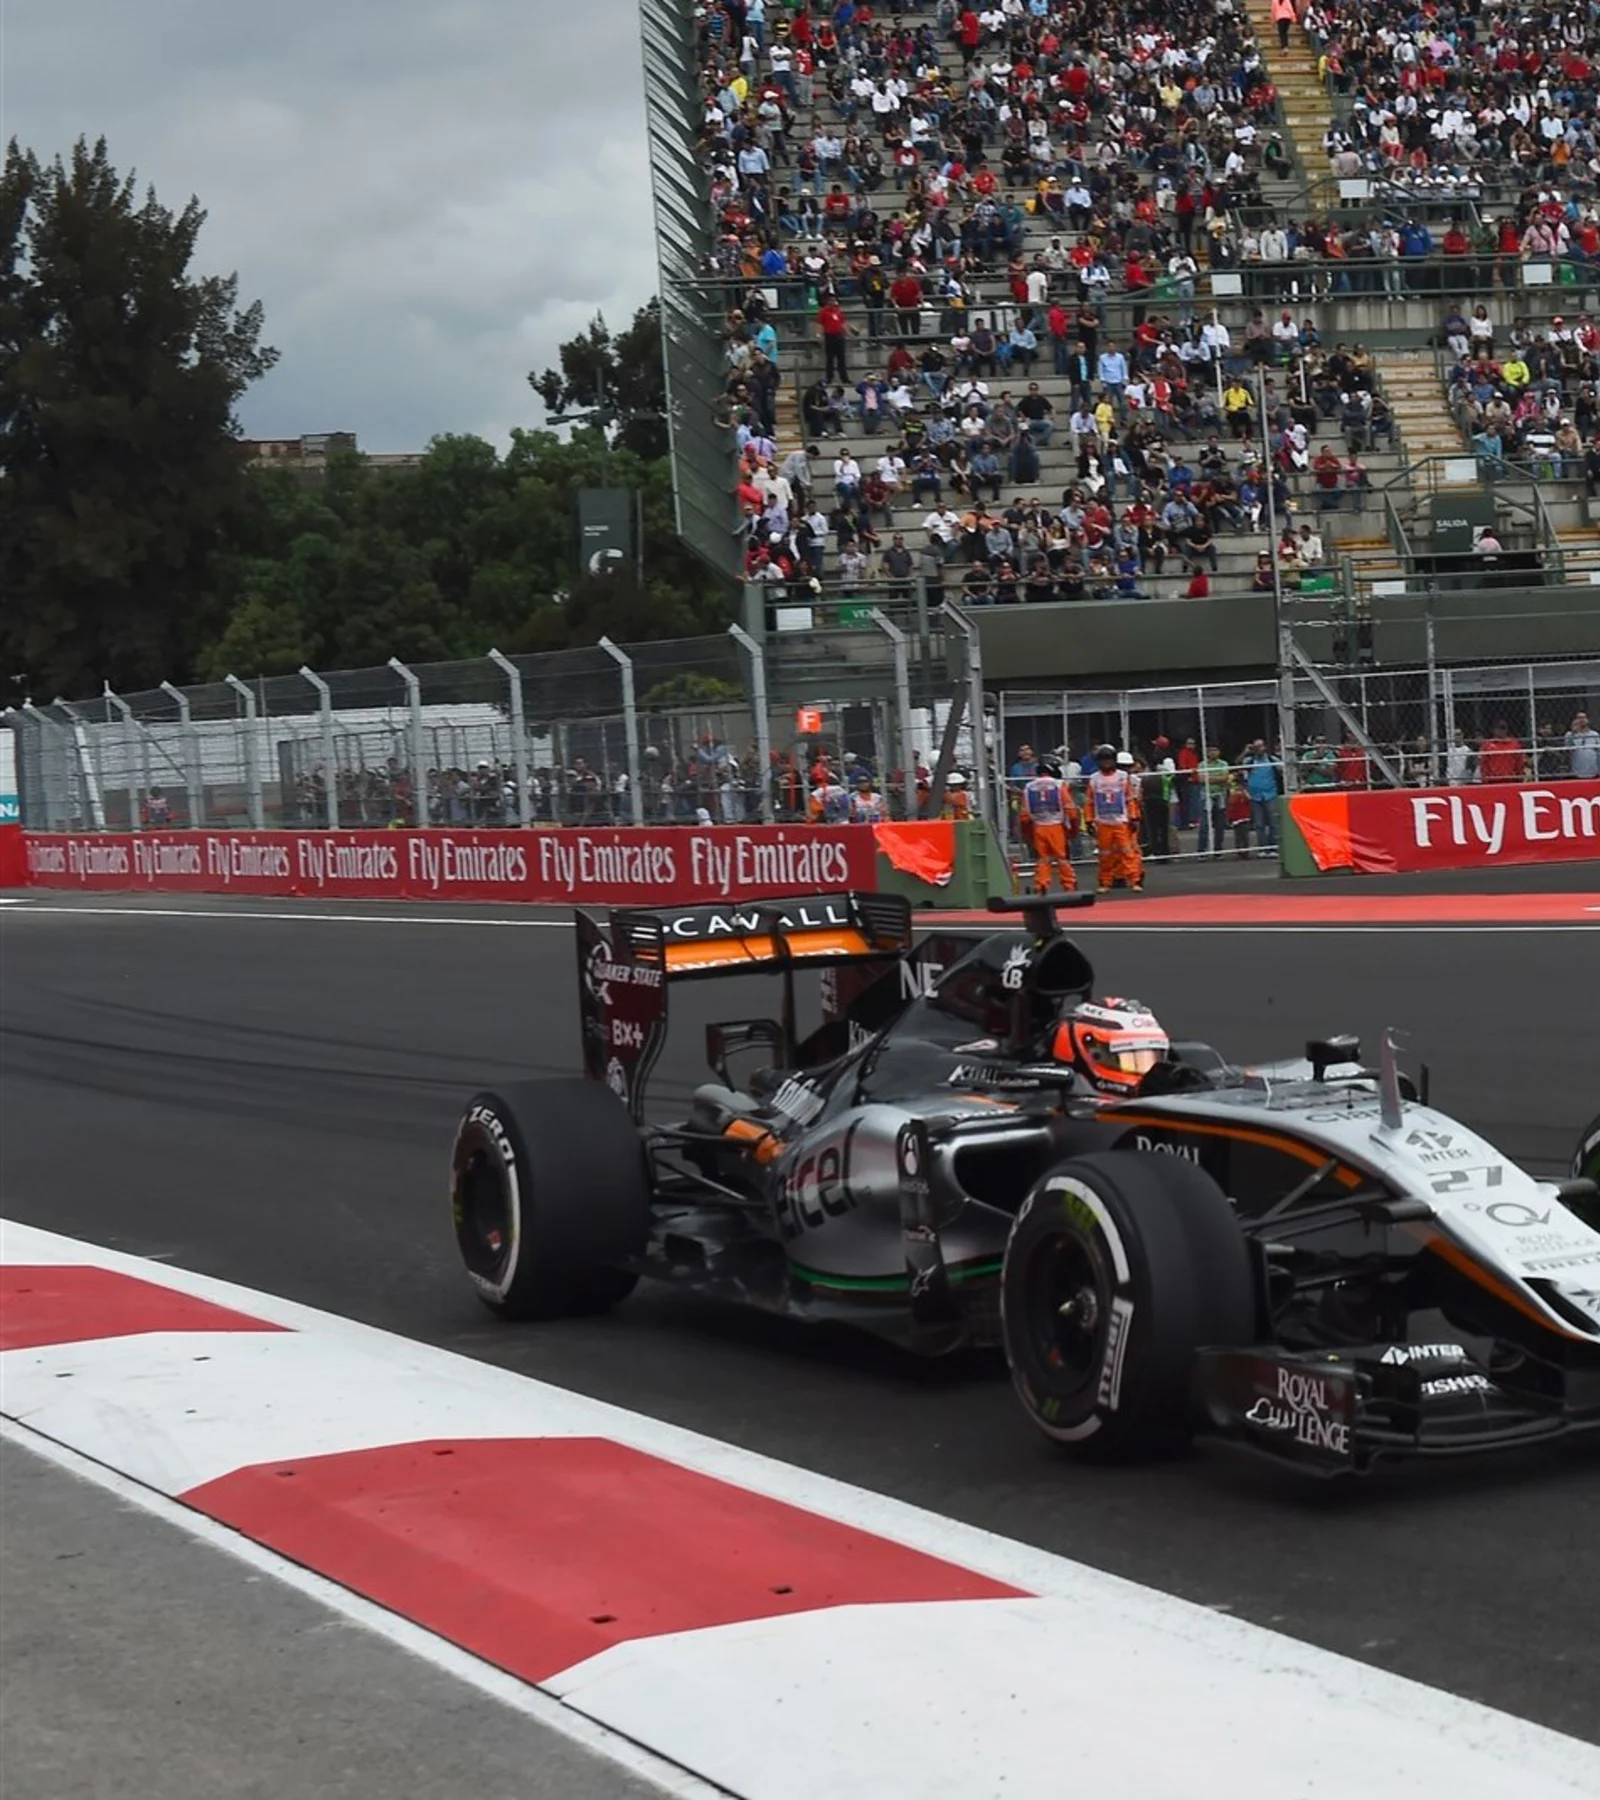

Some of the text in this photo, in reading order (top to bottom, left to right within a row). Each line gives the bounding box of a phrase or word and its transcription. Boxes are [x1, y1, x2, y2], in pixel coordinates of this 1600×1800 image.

[1436, 519, 1468, 528] SALIDA
[1412, 796, 1506, 854] Fly
[207, 836, 290, 884] Fly Emirates
[298, 837, 398, 887] Fly Emirates
[409, 836, 527, 889] Fly Emirates
[539, 835, 676, 891] Fly Emirates
[690, 832, 848, 895] Fly Emirates
[632, 966, 662, 988] STATE
[469, 1106, 515, 1161] ZERO
[1418, 1149, 1470, 1163] INTER
[1408, 1344, 1464, 1360] INTER
[1278, 1367, 1329, 1410] ROYAL
